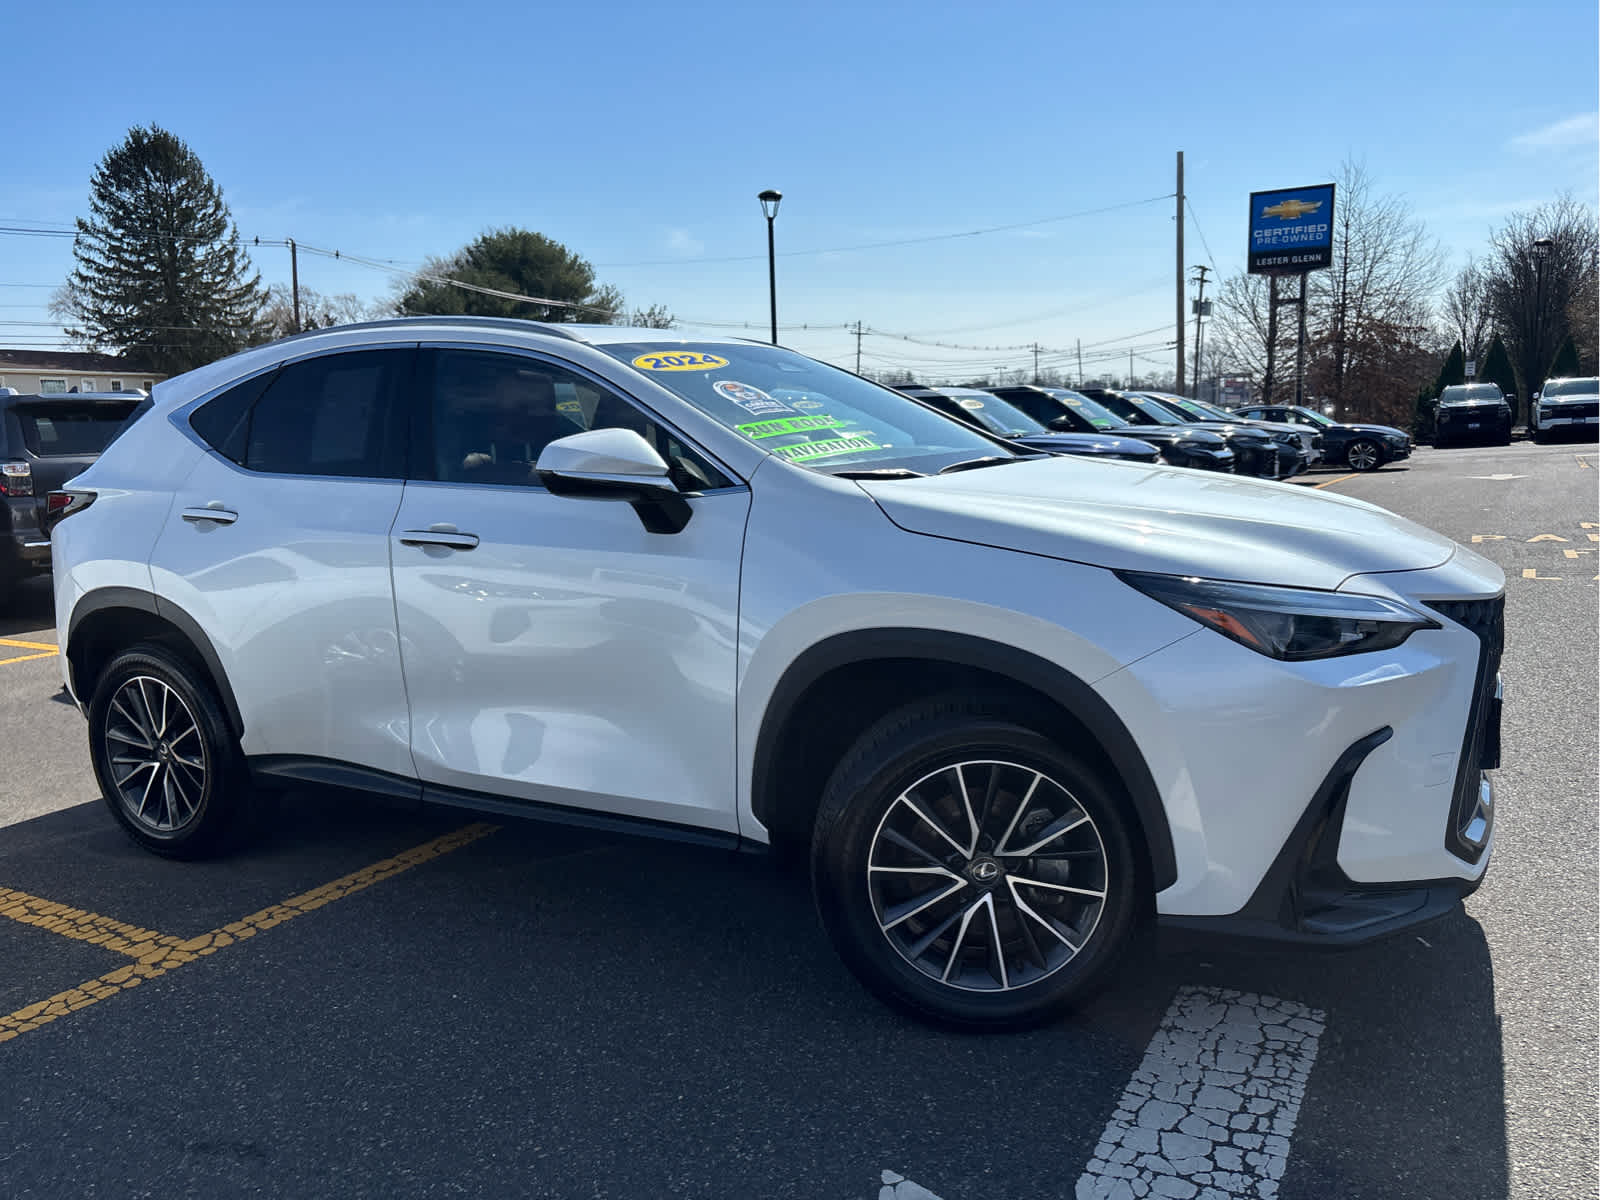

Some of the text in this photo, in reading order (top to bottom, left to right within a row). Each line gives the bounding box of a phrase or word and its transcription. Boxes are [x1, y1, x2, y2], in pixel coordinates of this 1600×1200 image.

[1254, 224, 1328, 238] CERTIFIED
[1256, 232, 1324, 246] PRE-OWNED
[1256, 253, 1322, 266] LESTER GLENN
[643, 354, 720, 369] 2024
[743, 422, 787, 436] SUN
[777, 437, 873, 459] NAVIGATION
[1471, 533, 1598, 543] PA
